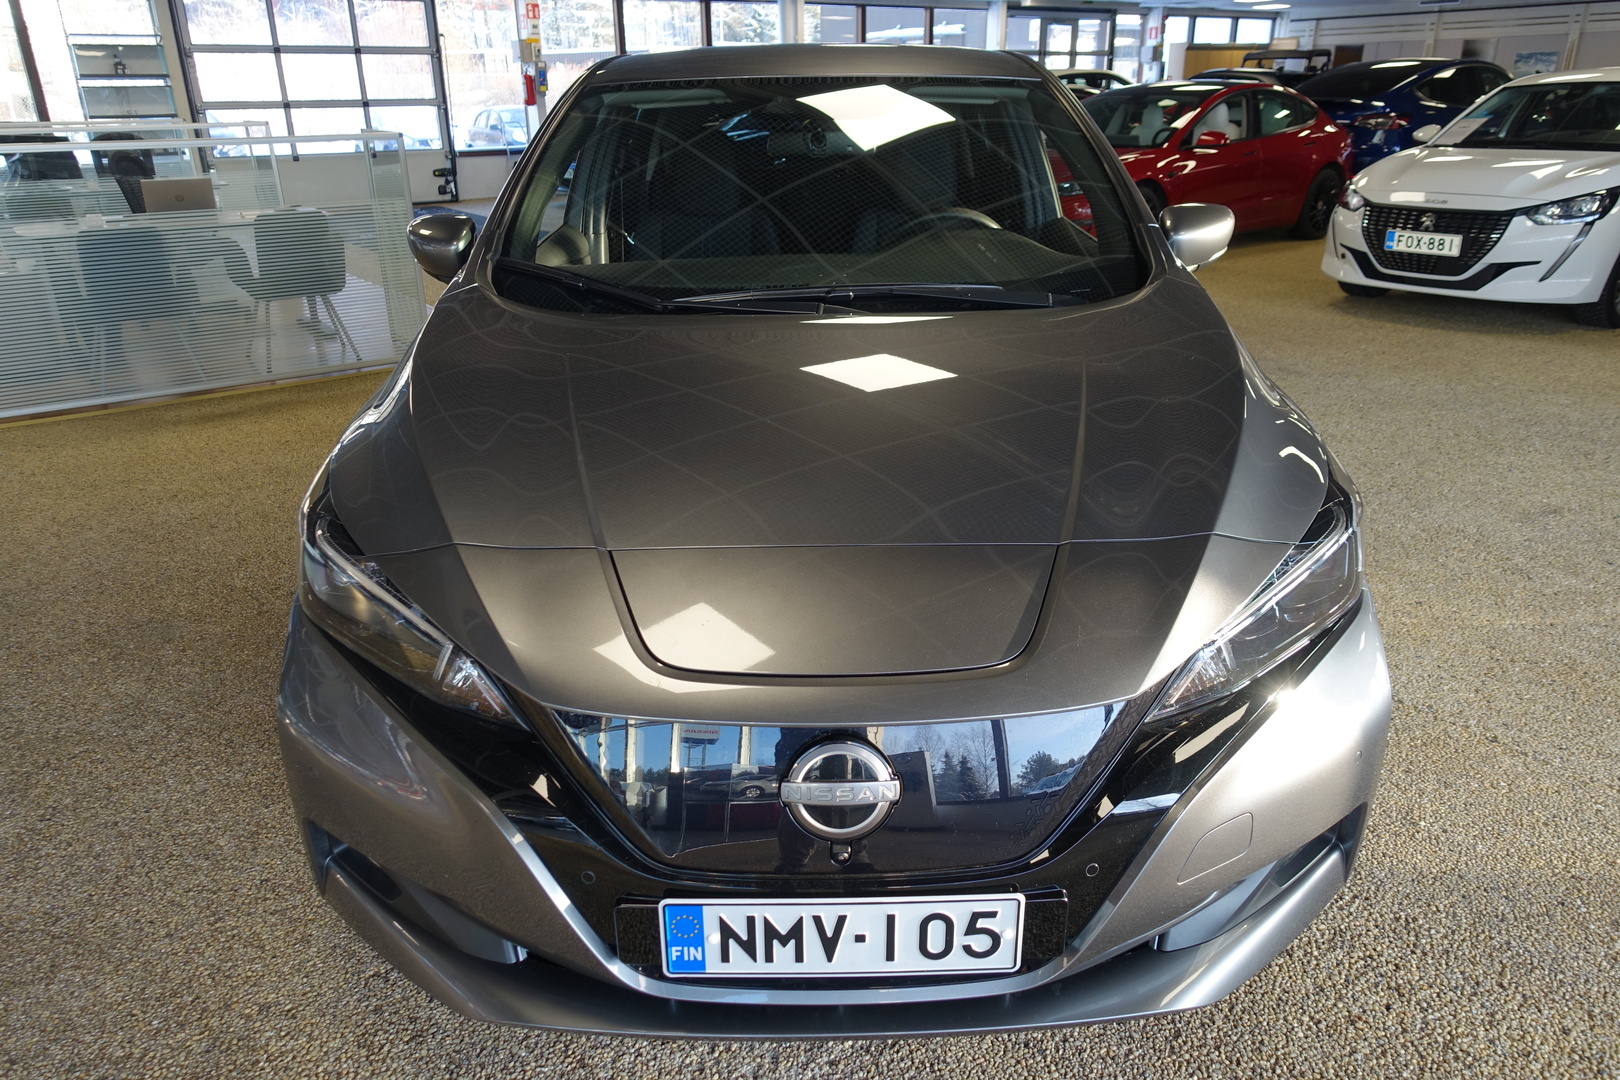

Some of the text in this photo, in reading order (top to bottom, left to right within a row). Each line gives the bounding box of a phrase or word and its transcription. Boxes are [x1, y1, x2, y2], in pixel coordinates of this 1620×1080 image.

[1396, 234, 1454, 252] FOX-881
[784, 783, 897, 802] NISSAN
[718, 910, 1002, 964] NMV-105
[671, 946, 703, 961] FIN
